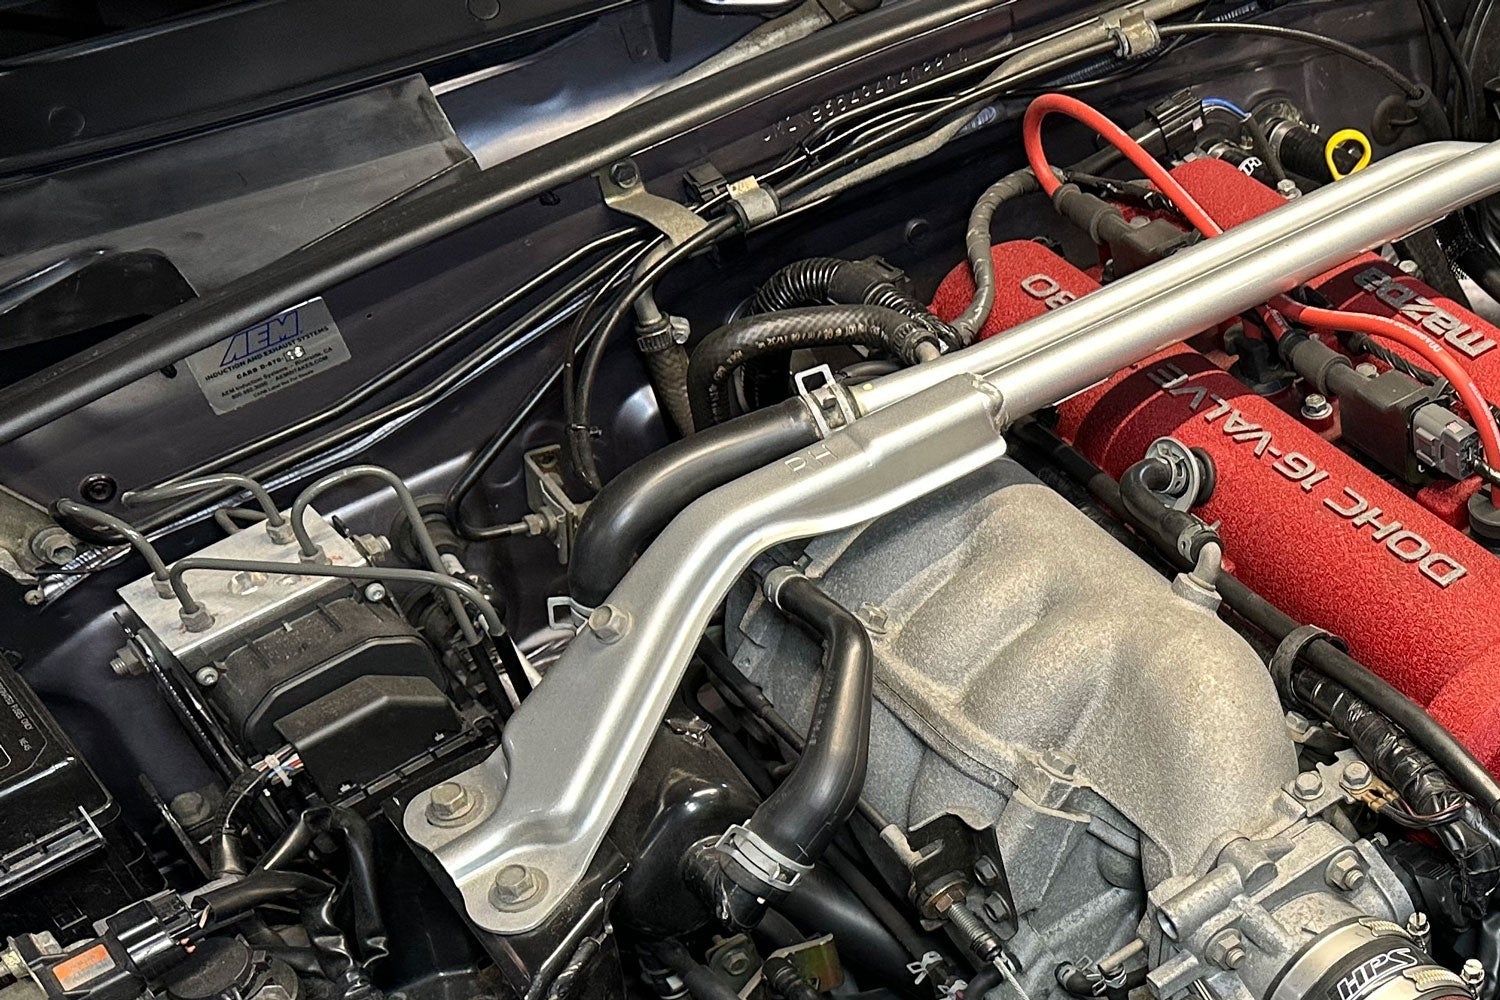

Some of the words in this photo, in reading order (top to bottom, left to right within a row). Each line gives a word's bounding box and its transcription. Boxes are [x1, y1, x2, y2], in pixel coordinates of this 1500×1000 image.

[205, 361, 246, 381] INDUCTION
[247, 354, 263, 364] AND
[264, 340, 298, 357] EXHAUST
[298, 325, 329, 342] SYSTEMS
[220, 310, 299, 367] AEM
[1147, 362, 1330, 491] 16-VALVE
[1323, 486, 1469, 588] DOHC
